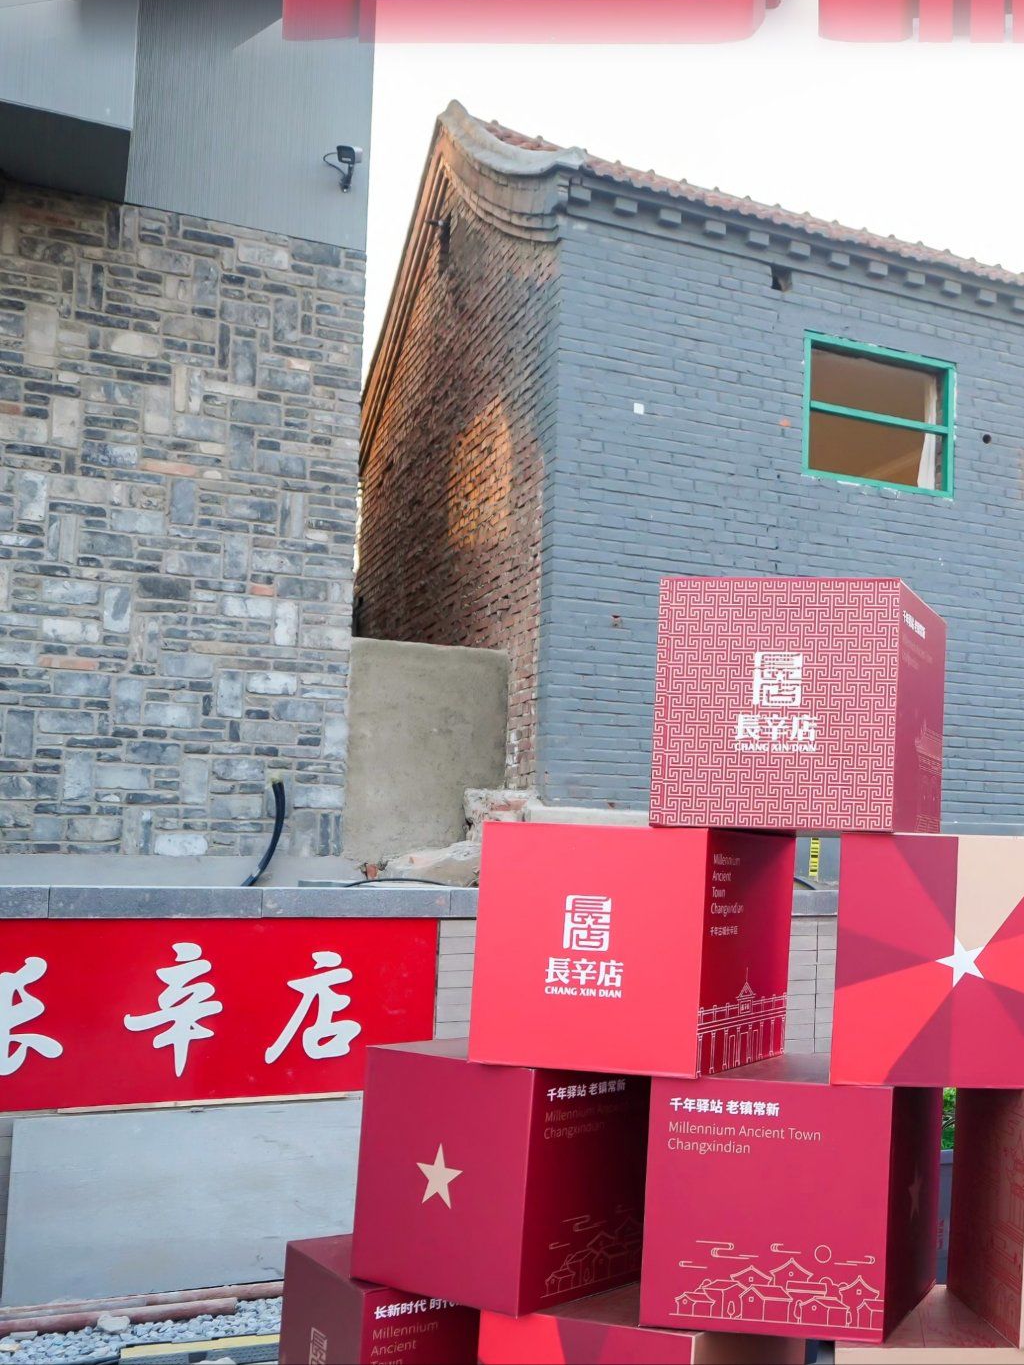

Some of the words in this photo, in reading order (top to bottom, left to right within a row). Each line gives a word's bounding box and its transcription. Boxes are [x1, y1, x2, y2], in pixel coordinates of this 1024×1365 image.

[735, 714, 817, 741] 長辛店
[735, 743, 768, 751] CHANG
[772, 743, 790, 752] XIN
[792, 743, 816, 752] DIAN
[712, 870, 732, 882] Ancient
[712, 886, 726, 897] Town
[710, 900, 744, 917] Changxindian
[545, 957, 624, 987] 長辛店
[545, 986, 577, 996] CHANG
[579, 987, 596, 997] XIN
[599, 989, 622, 998] DIAN
[670, 1097, 723, 1114] 千年驿站
[726, 1100, 780, 1117] 老镇常新
[668, 1121, 736, 1136] Millennium
[738, 1125, 785, 1140] Ancient
[788, 1127, 821, 1142] Town
[668, 1137, 751, 1155] Changxindian
[374, 1299, 427, 1320] 长新时代
[372, 1320, 439, 1340] Millennium
[371, 1339, 417, 1357] Ancient
